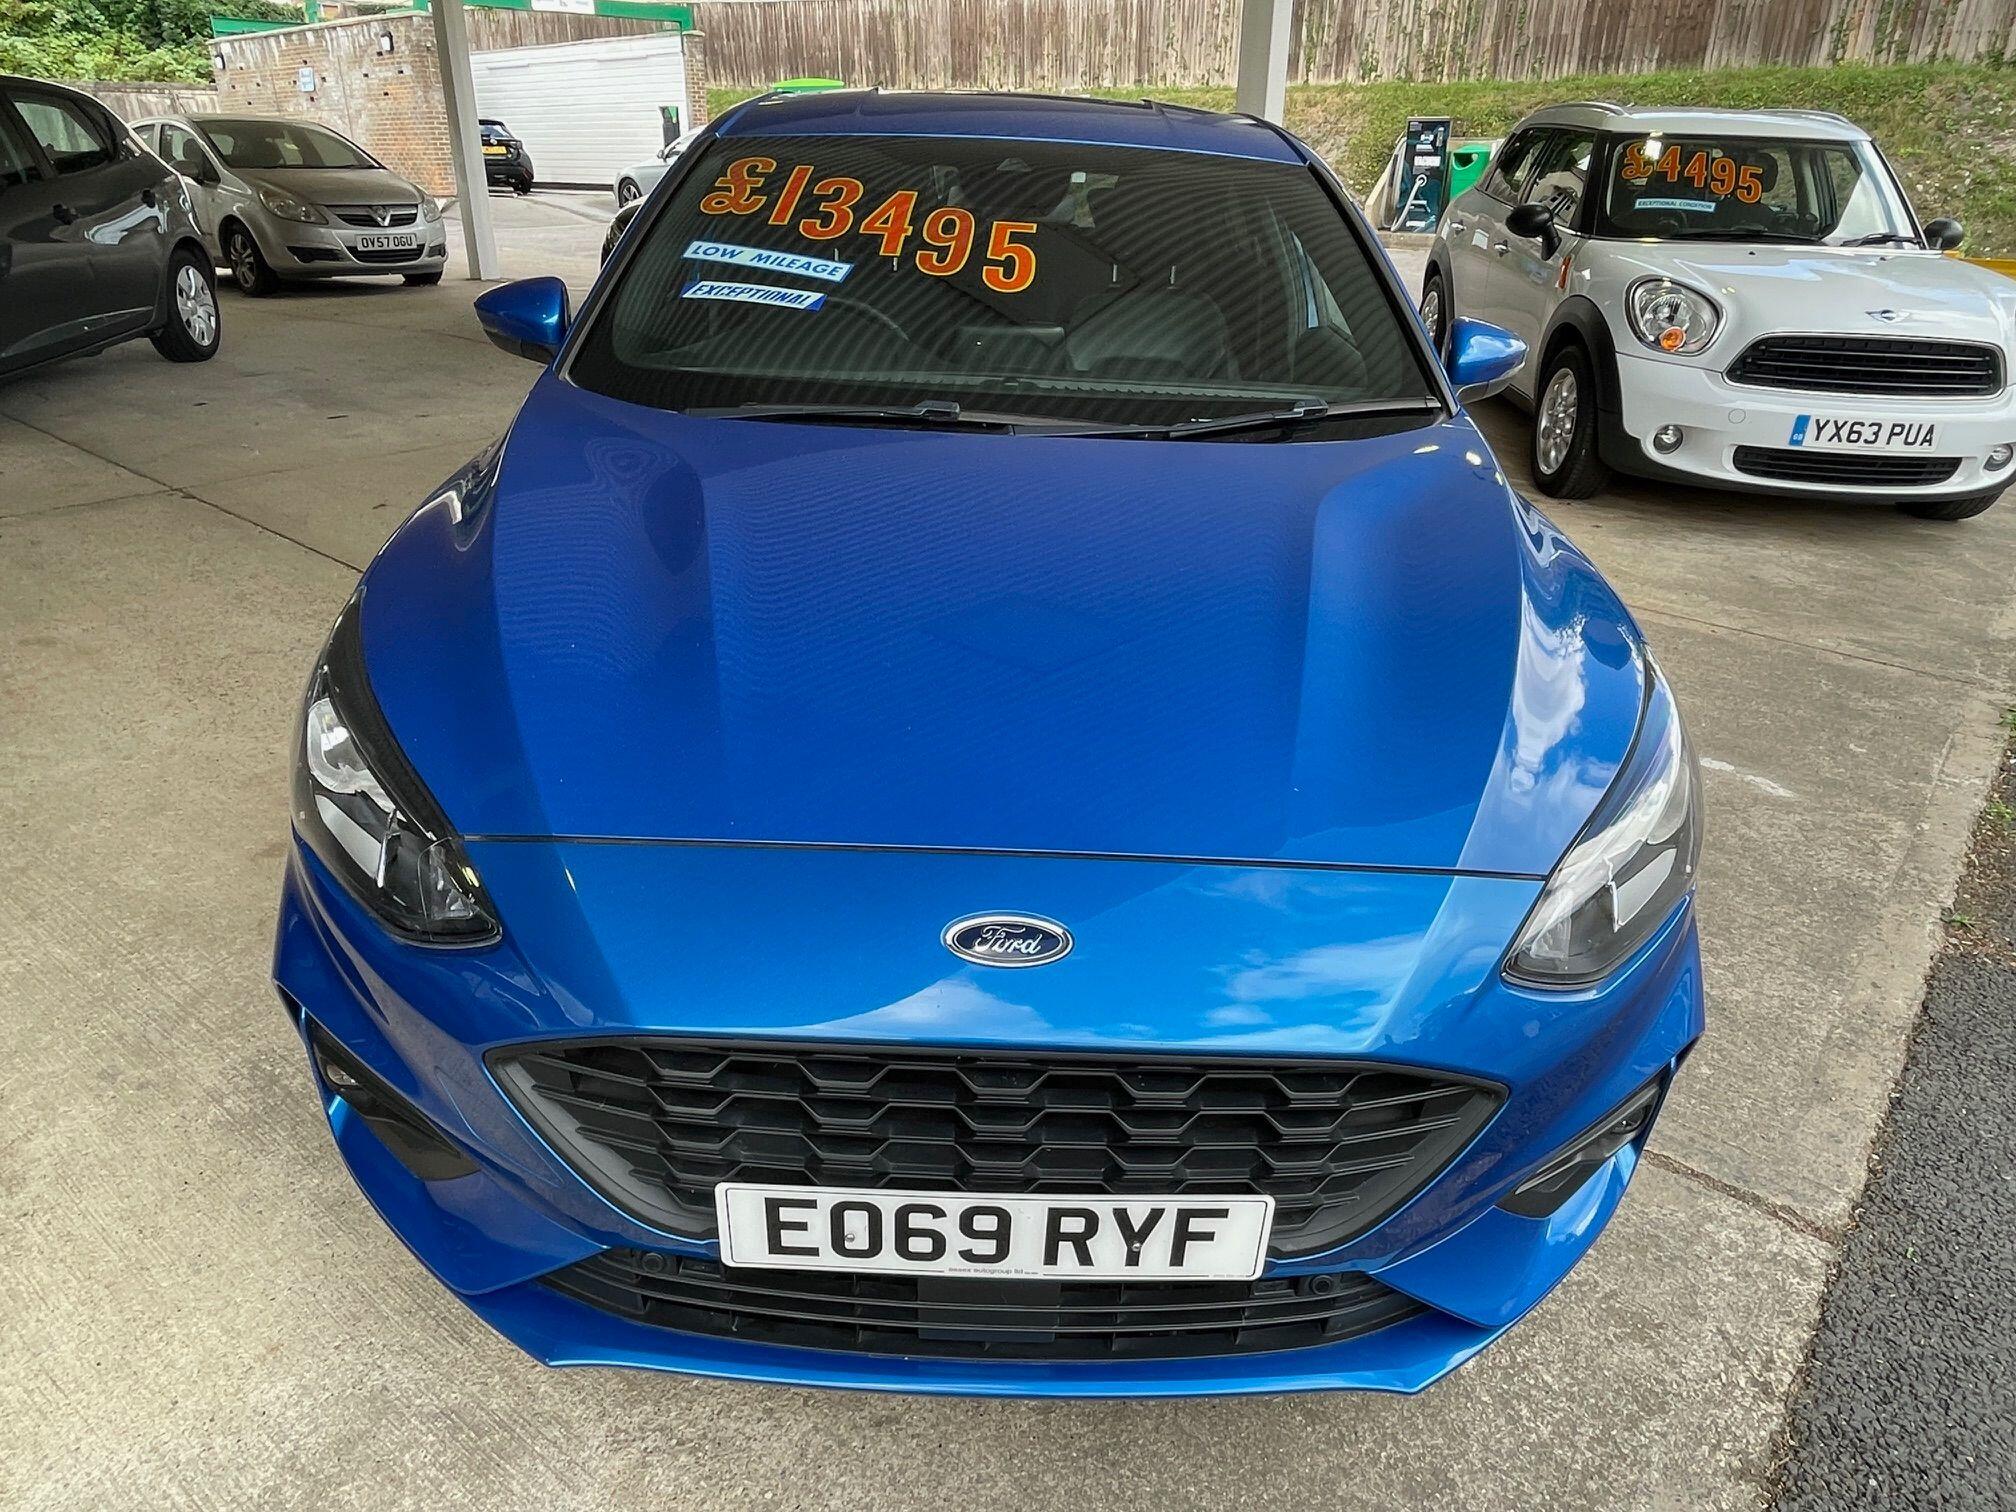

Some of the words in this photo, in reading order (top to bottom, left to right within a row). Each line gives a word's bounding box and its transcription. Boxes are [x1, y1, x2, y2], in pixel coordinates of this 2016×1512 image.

[1622, 142, 1763, 204] £4495
[700, 157, 1037, 293] £13495
[393, 235, 413, 247] OGU
[691, 245, 743, 259] LOW
[750, 253, 844, 276] MILEAGE
[690, 284, 810, 305] EXCEPTIONAL
[1814, 418, 1883, 445] YX63
[1886, 423, 1935, 447] PUA
[974, 926, 1043, 953] Ford
[764, 1197, 1012, 1264] EO69
[1042, 1207, 1230, 1267] RYF
